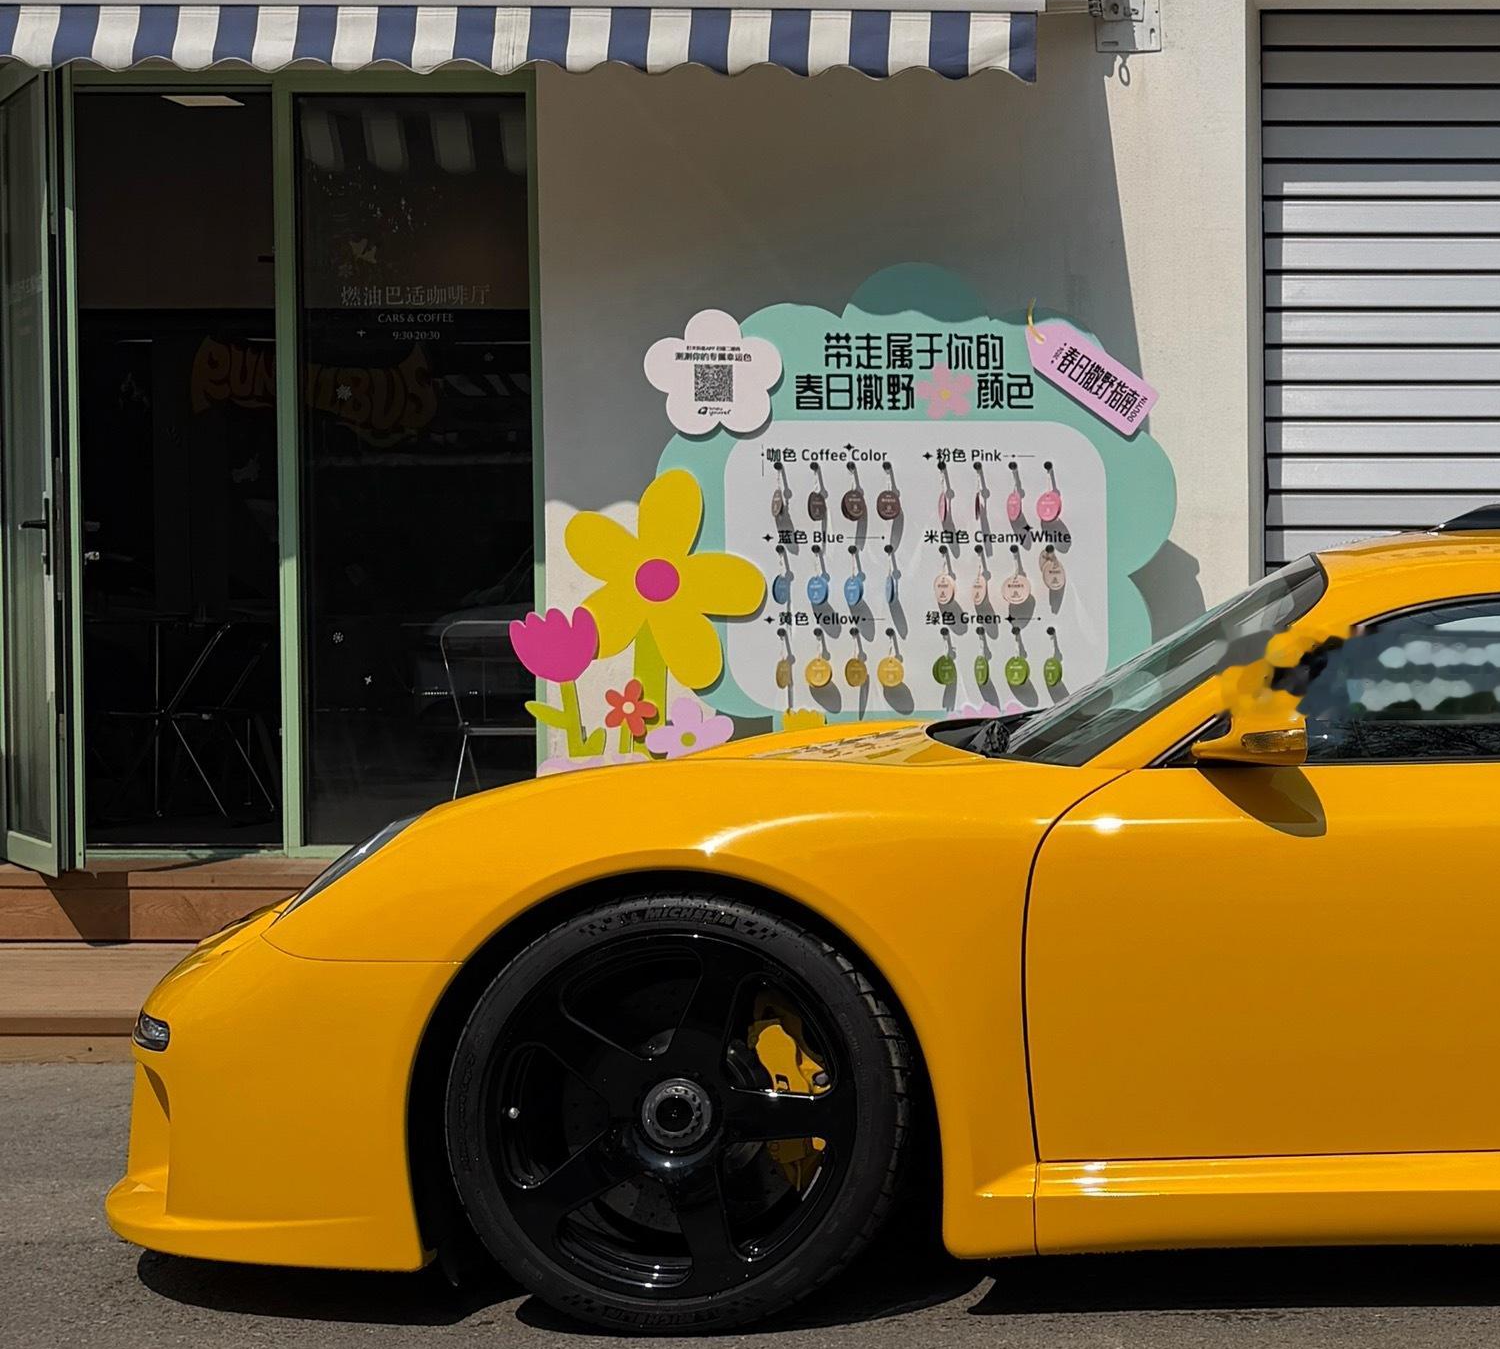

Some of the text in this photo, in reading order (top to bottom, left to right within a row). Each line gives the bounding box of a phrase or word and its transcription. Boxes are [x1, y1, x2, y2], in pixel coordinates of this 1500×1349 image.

[340, 283, 491, 307] 燃油巴适咖啡厅
[377, 313, 455, 323] CARS & COFFEE
[824, 332, 1005, 370] 带走属于你的
[1056, 345, 1141, 418] 春日撒野指南
[795, 372, 1034, 411] 春日撒野 颜色
[1126, 394, 1149, 423] DOUYIN
[766, 447, 888, 462] 咖色 Coffee Color
[936, 447, 1002, 463] 粉色 Pink
[778, 530, 844, 544] 蓝色 Blue
[924, 529, 1072, 546] 米白色 Creamy White
[778, 611, 860, 626] 黄色 Yellow
[925, 611, 1001, 626] 绿色 Green
